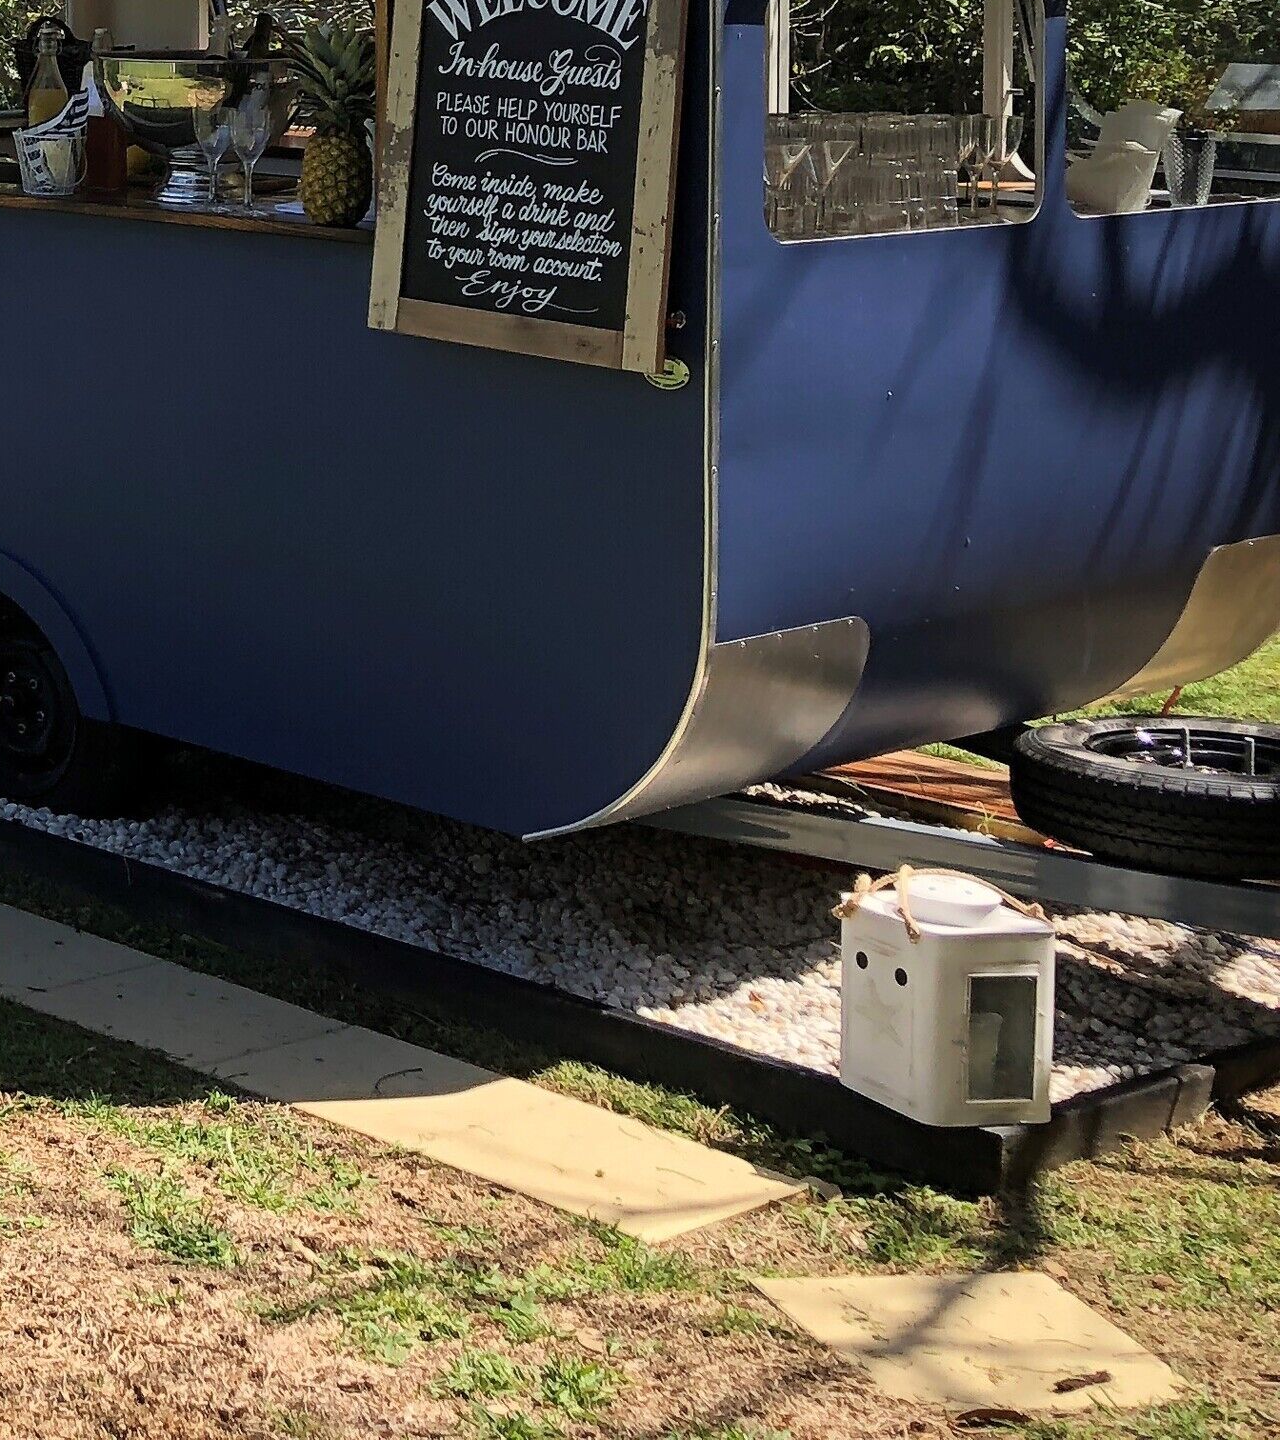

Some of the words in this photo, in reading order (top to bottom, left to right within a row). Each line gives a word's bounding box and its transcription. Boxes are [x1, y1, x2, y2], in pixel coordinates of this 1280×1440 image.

[439, 41, 543, 83] In-house
[540, 45, 622, 96] Guests
[436, 92, 490, 115] PLEASE
[497, 97, 538, 121] HELP
[544, 101, 622, 128] YOURSELF
[440, 115, 458, 135] TO
[465, 118, 499, 140] OUR
[505, 122, 571, 149] HONOUR
[577, 128, 608, 154] BAR
[432, 162, 477, 191] Come
[481, 171, 537, 204] inside,
[543, 180, 604, 205] make
[423, 193, 499, 227] yourself
[502, 202, 516, 219] a
[518, 200, 571, 227] drink
[573, 208, 616, 233] and
[429, 215, 470, 238] then
[476, 221, 520, 248] sign
[518, 227, 556, 251] your
[554, 230, 623, 257] selection
[426, 237, 447, 260] to
[444, 246, 486, 269] your
[487, 248, 530, 272] room
[533, 258, 602, 282] account.
[454, 270, 599, 313] Enjoy
